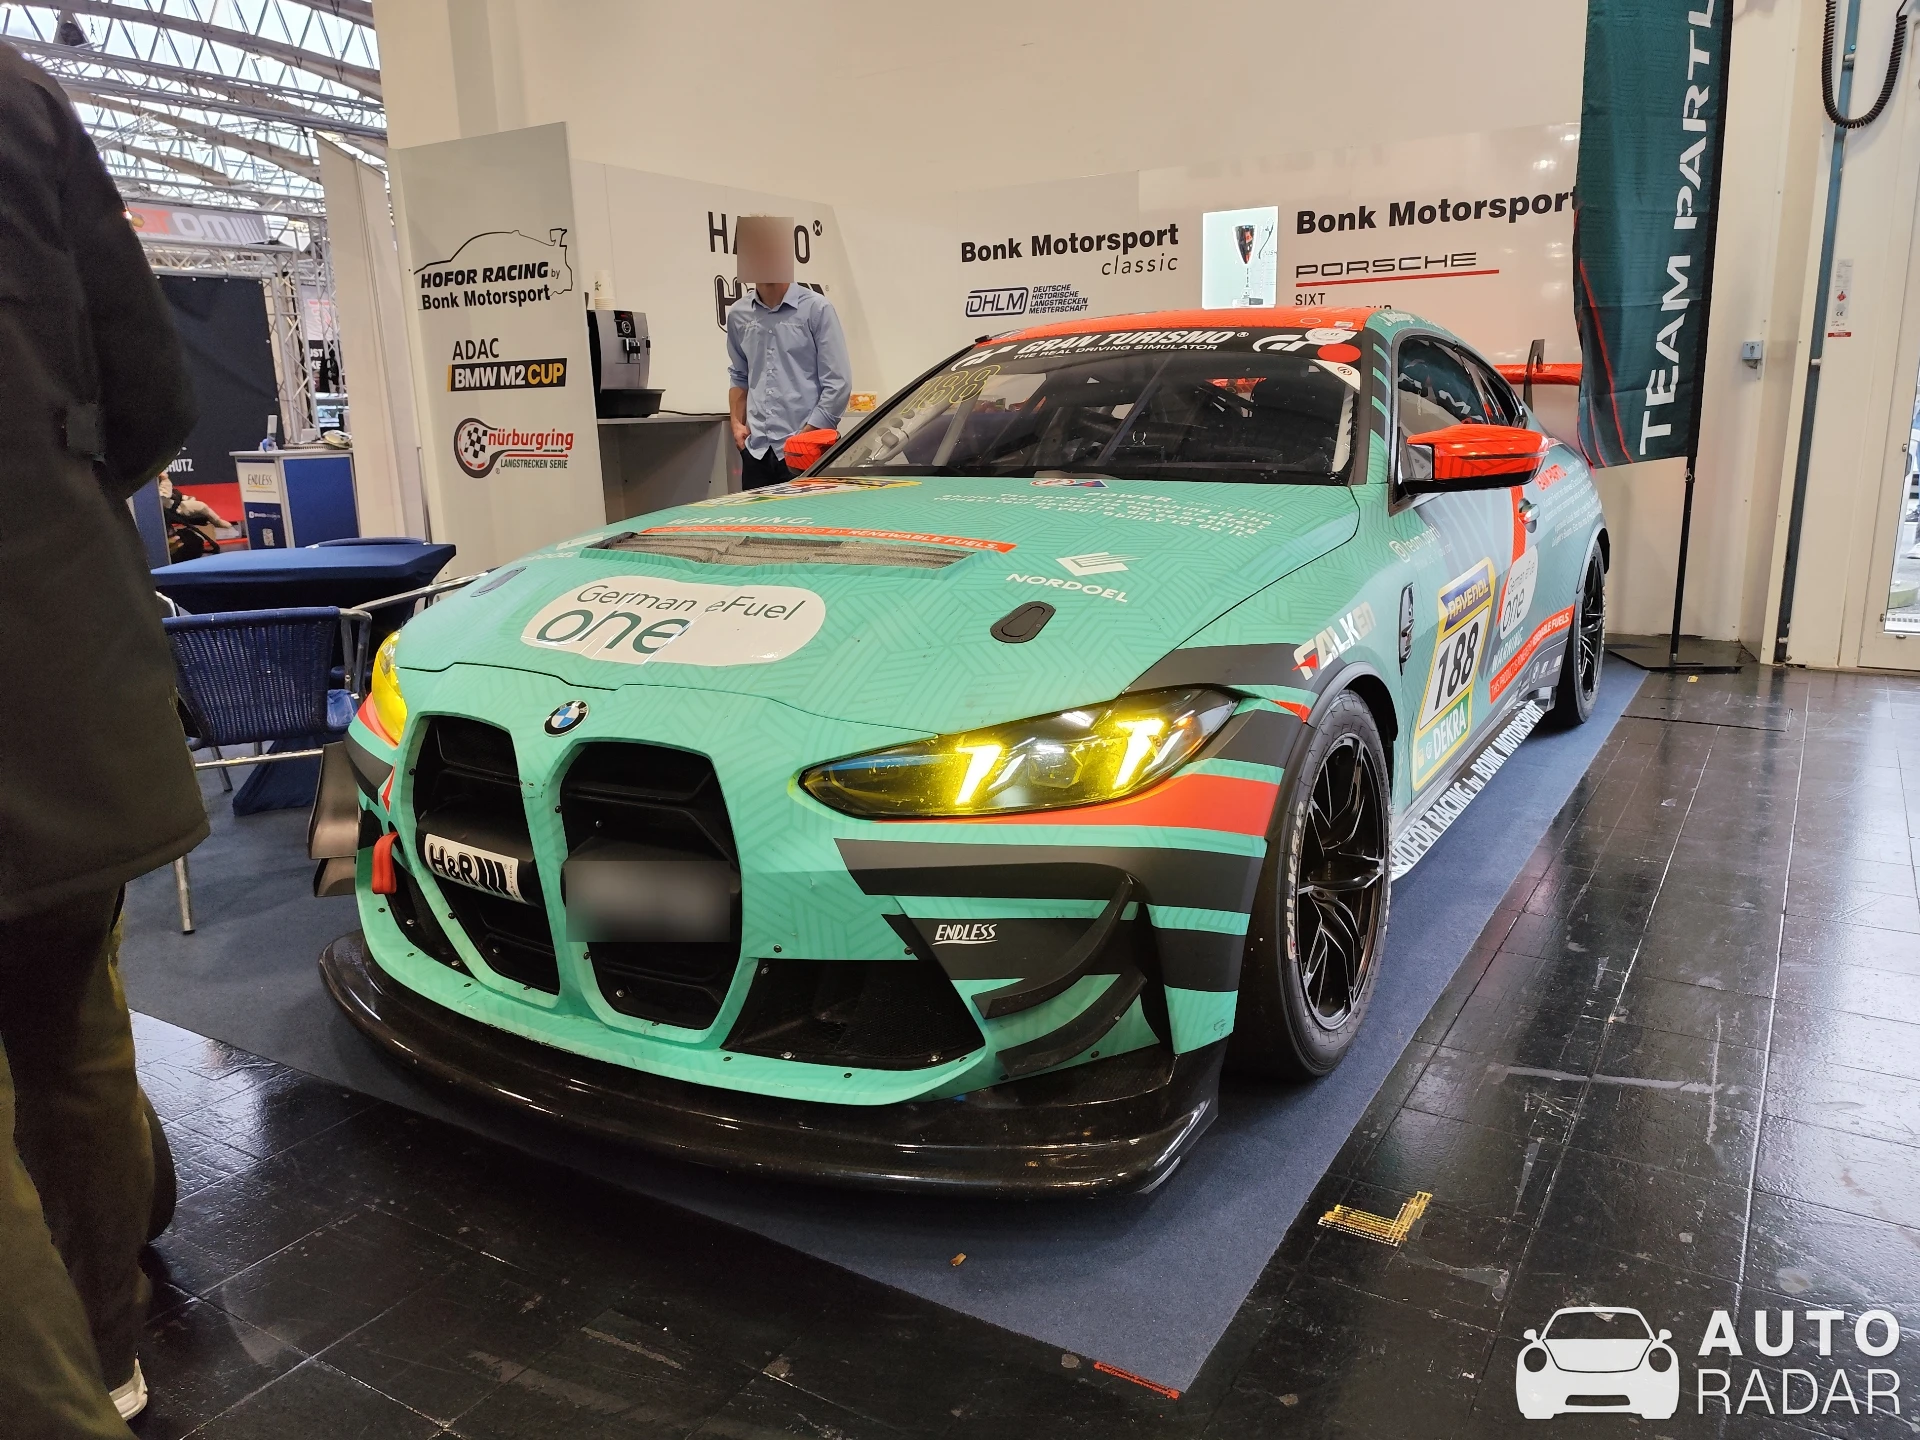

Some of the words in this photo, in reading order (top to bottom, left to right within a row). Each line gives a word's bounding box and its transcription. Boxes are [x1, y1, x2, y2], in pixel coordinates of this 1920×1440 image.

[1296, 205, 1377, 234] Bonk
[962, 238, 1023, 263] Bonk
[1031, 224, 1179, 256] Motorsport
[420, 269, 477, 289] HOFOR
[482, 261, 549, 284] RACING
[551, 268, 561, 280] by
[1101, 253, 1178, 276] classic
[1296, 252, 1477, 279] PORSCHE
[421, 292, 459, 310] Bonk
[464, 284, 550, 308] Motorsport
[1031, 290, 1080, 300] HISTORISCHE
[1033, 284, 1072, 293] DEUTSCHE
[1295, 293, 1325, 306] SIXT
[969, 292, 1024, 313] DHLM
[1028, 304, 1089, 315] MEISTERSCHAFT
[1030, 297, 1089, 307] LANGSTRECKEN
[452, 338, 500, 360] ADAC
[1013, 352, 1035, 360] THE
[1037, 349, 1072, 357] REAL
[1075, 345, 1130, 353] DRIVING
[1017, 334, 1101, 355] GRAN
[1104, 330, 1236, 347] TURISMO
[1639, 255, 1691, 455] TEAM
[454, 366, 498, 389] BMW
[500, 365, 526, 387] M2
[527, 362, 565, 384] CUP
[488, 428, 575, 451] nürburgring
[500, 459, 548, 469] LANGSTRECKEN
[549, 459, 568, 469] SERIE
[1103, 511, 1165, 523] ability
[1197, 524, 1222, 532] do
[848, 529, 944, 543] RENEWABLE
[945, 537, 999, 550] FUELS.
[1005, 573, 1129, 603] NORDOEL
[1447, 577, 1490, 620] RAVENOL
[577, 585, 698, 612] German
[704, 595, 806, 621] eFuel
[536, 609, 692, 655] one
[1434, 621, 1480, 712] 188
[1433, 701, 1467, 761] DEKRA
[1425, 781, 1472, 830] RACING
[1470, 745, 1507, 783] BONK
[1491, 699, 1545, 757] MOTORSPORT
[934, 923, 998, 941] ENDLESS
